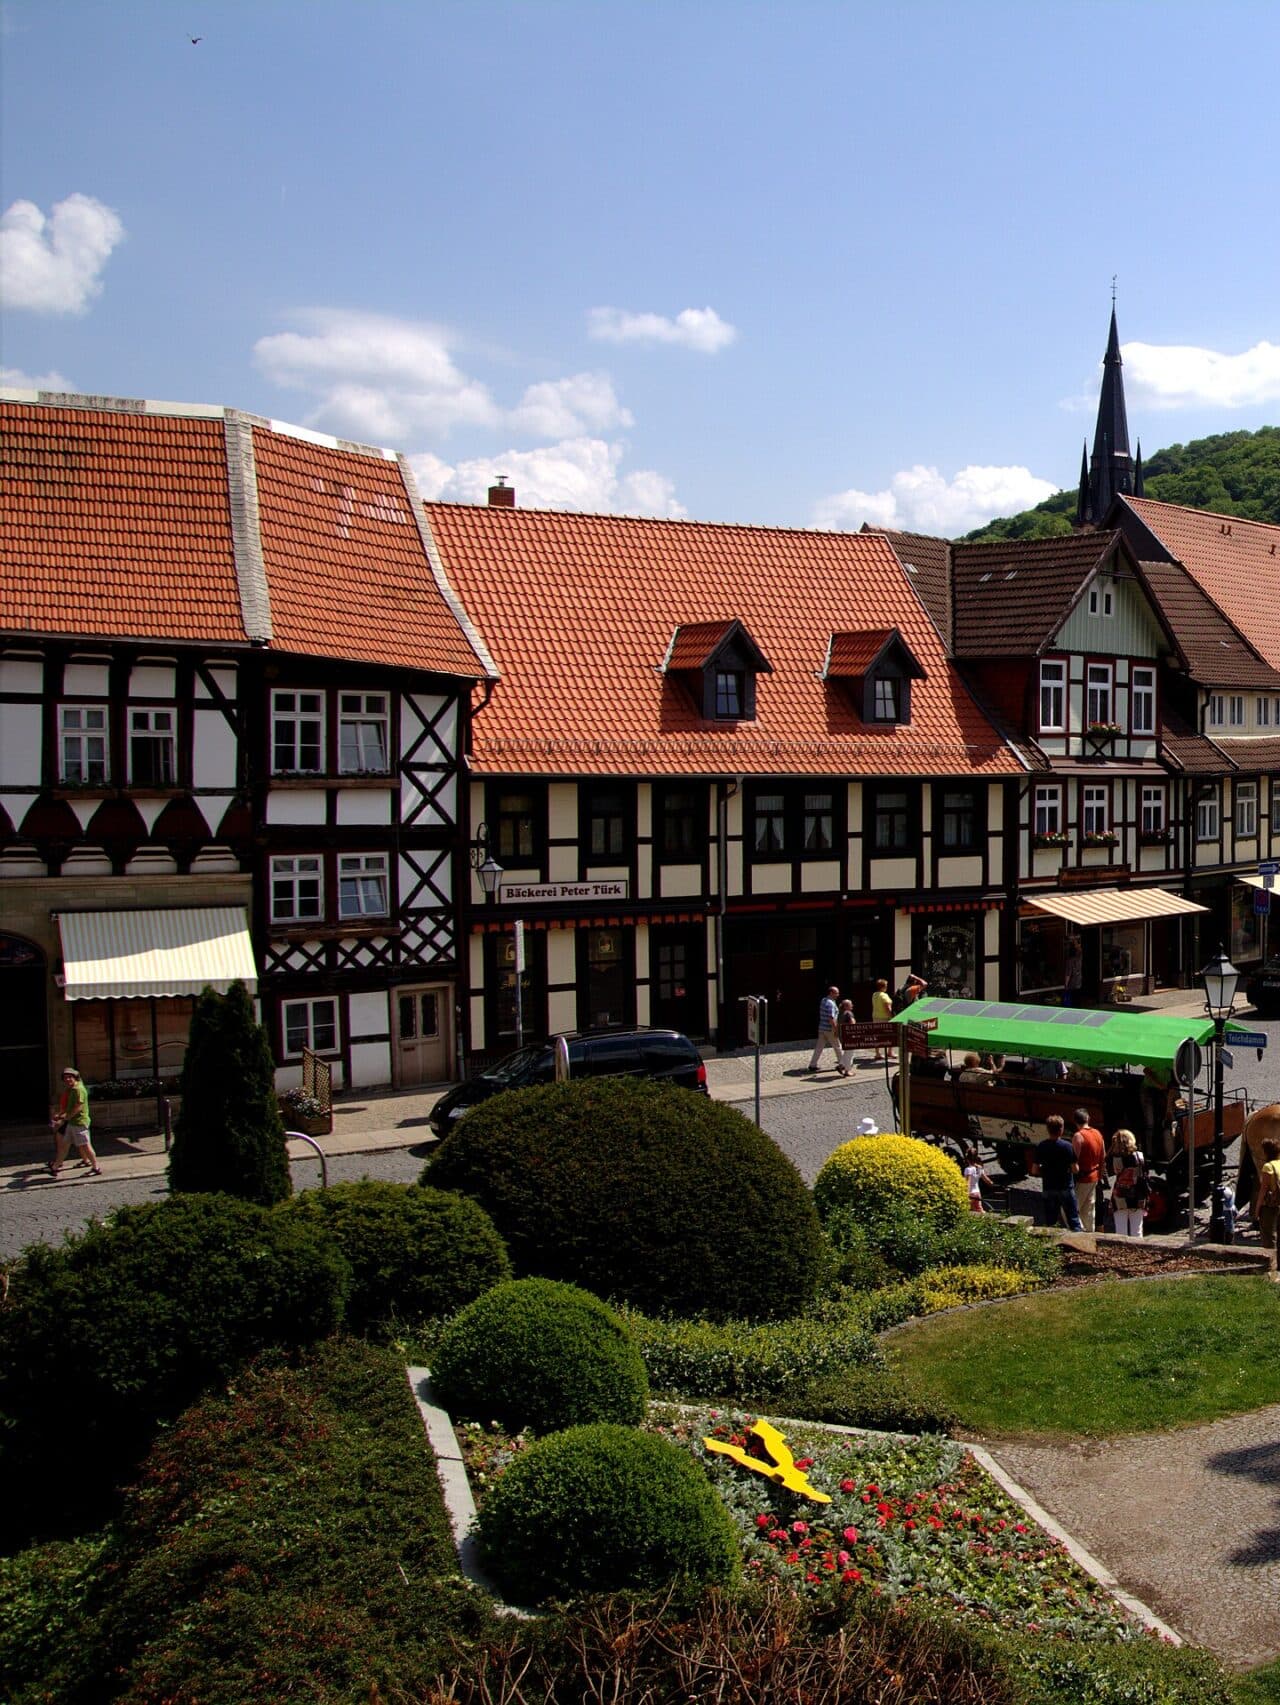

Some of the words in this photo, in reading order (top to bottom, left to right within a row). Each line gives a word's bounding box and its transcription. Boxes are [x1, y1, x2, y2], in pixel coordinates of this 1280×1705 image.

[506, 887, 557, 898] Bäckerei
[561, 886, 590, 897] Peter
[592, 885, 621, 895] Türk
